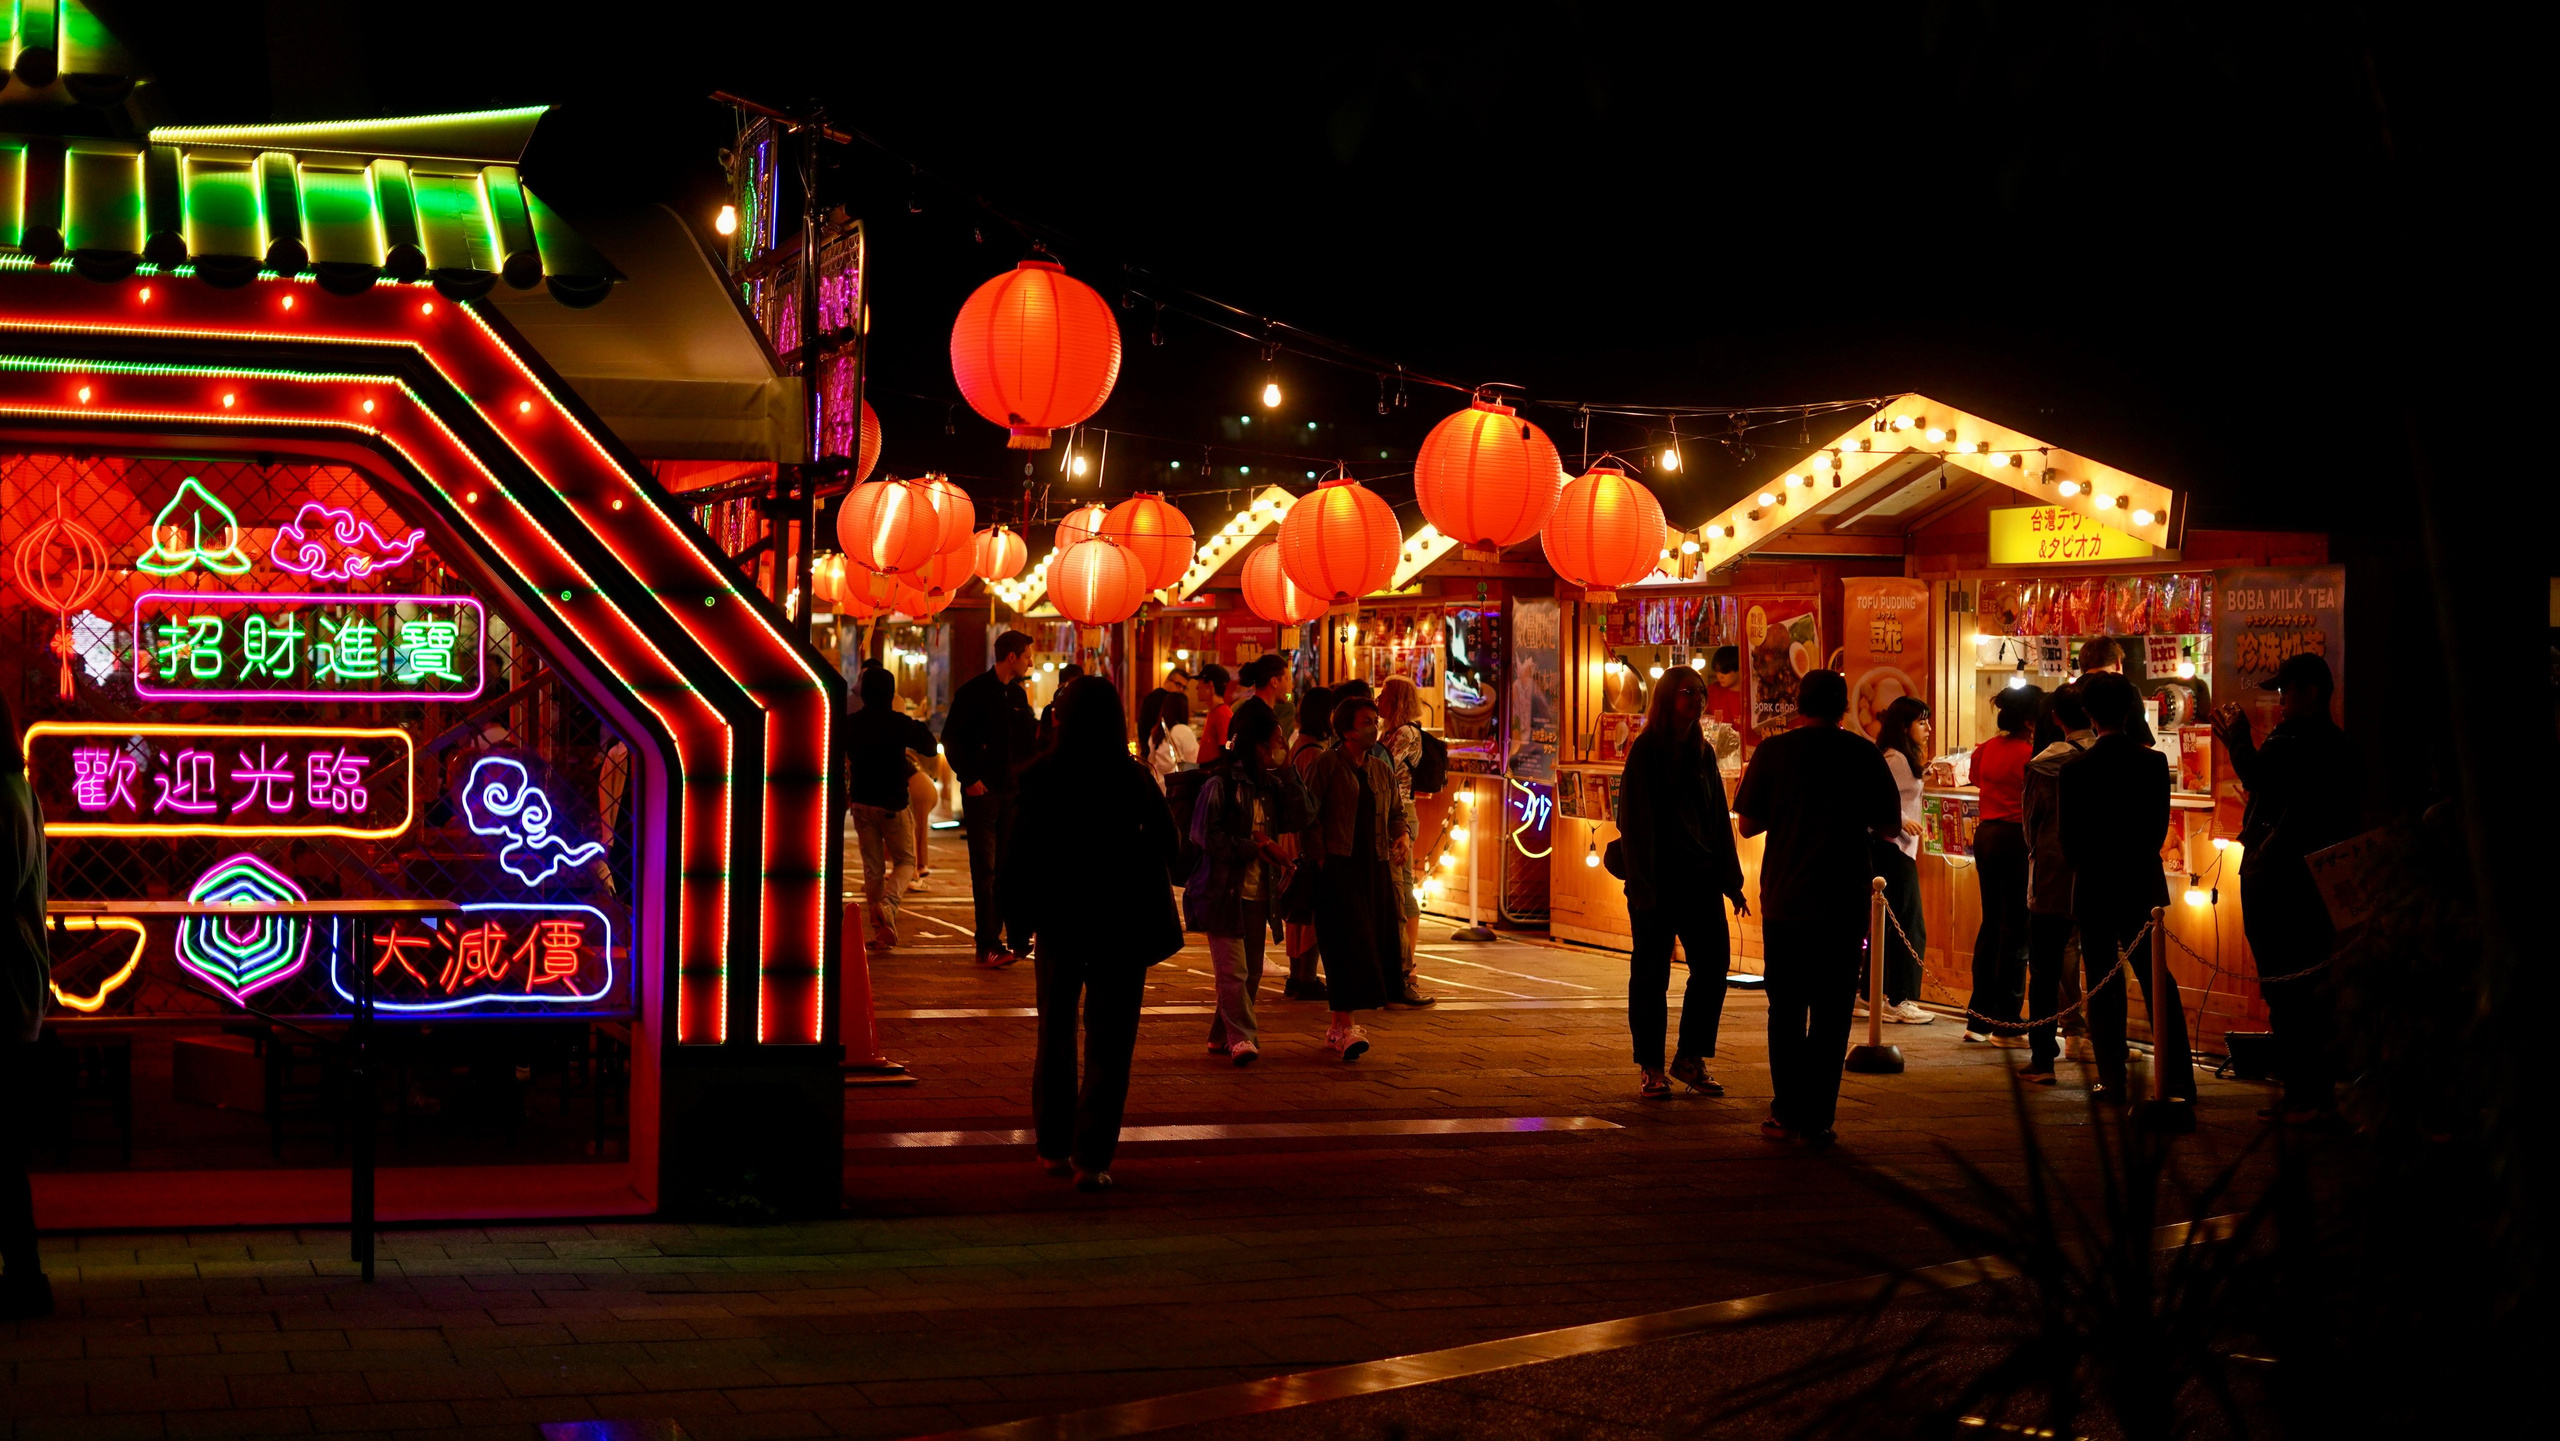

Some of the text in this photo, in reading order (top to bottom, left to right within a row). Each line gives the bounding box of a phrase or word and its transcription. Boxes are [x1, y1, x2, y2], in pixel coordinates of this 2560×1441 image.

[1857, 596, 1916, 609] TOFU PUDDING
[2227, 587, 2336, 612] BOBA MILK TEA
[158, 612, 463, 683] 招財進寶
[1870, 621, 1903, 653] 豆花
[1754, 702, 1795, 713] PORK CHOP
[71, 742, 370, 815] 歡迎光臨
[372, 920, 583, 997] 大減價
